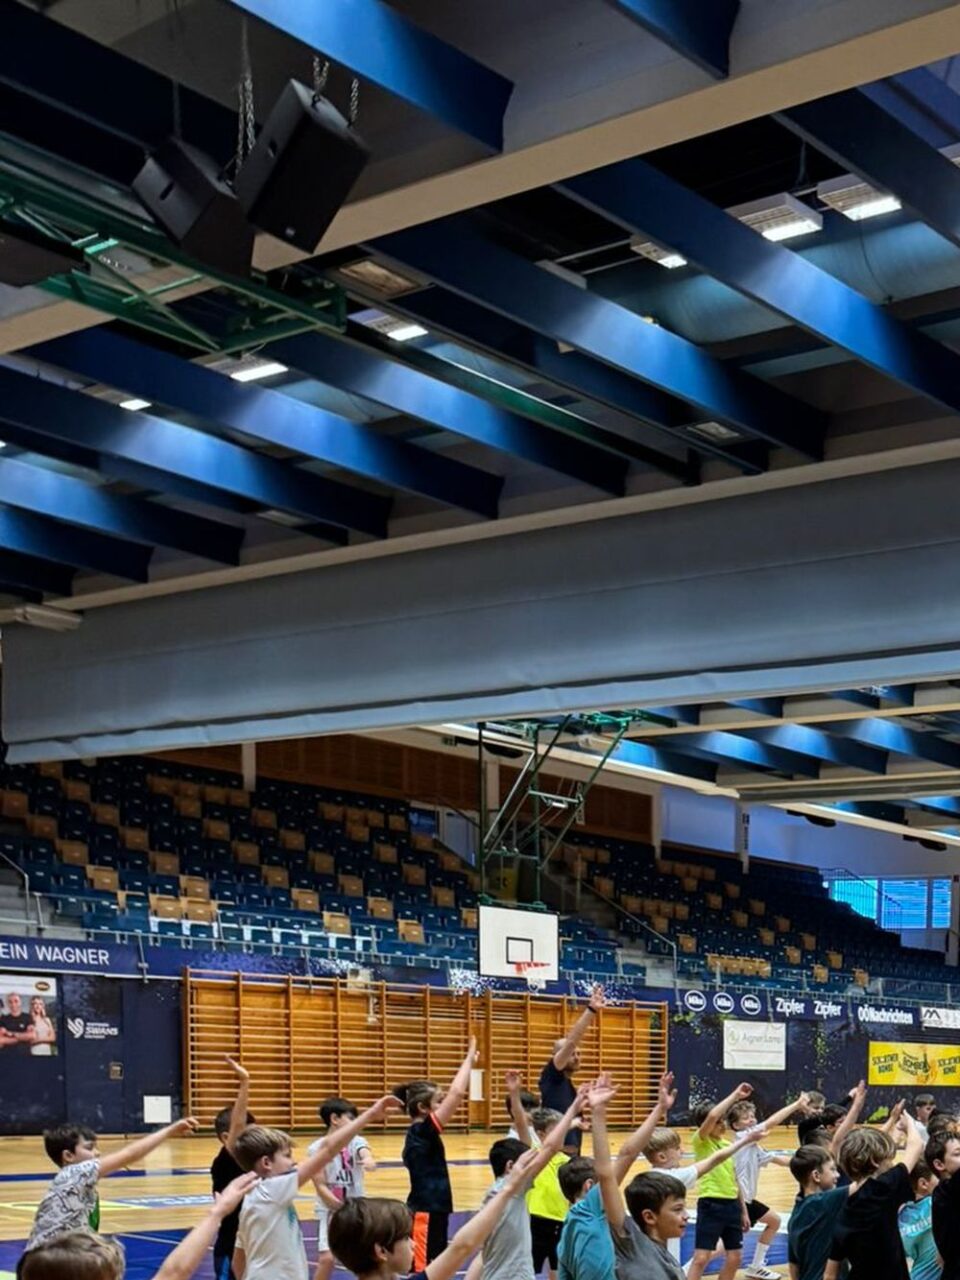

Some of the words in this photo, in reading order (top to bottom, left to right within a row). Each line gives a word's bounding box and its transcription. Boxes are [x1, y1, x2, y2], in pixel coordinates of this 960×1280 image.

[35, 945, 110, 965] WAGNER
[775, 997, 805, 1017] Zipfer
[813, 1000, 841, 1019] Zipfer
